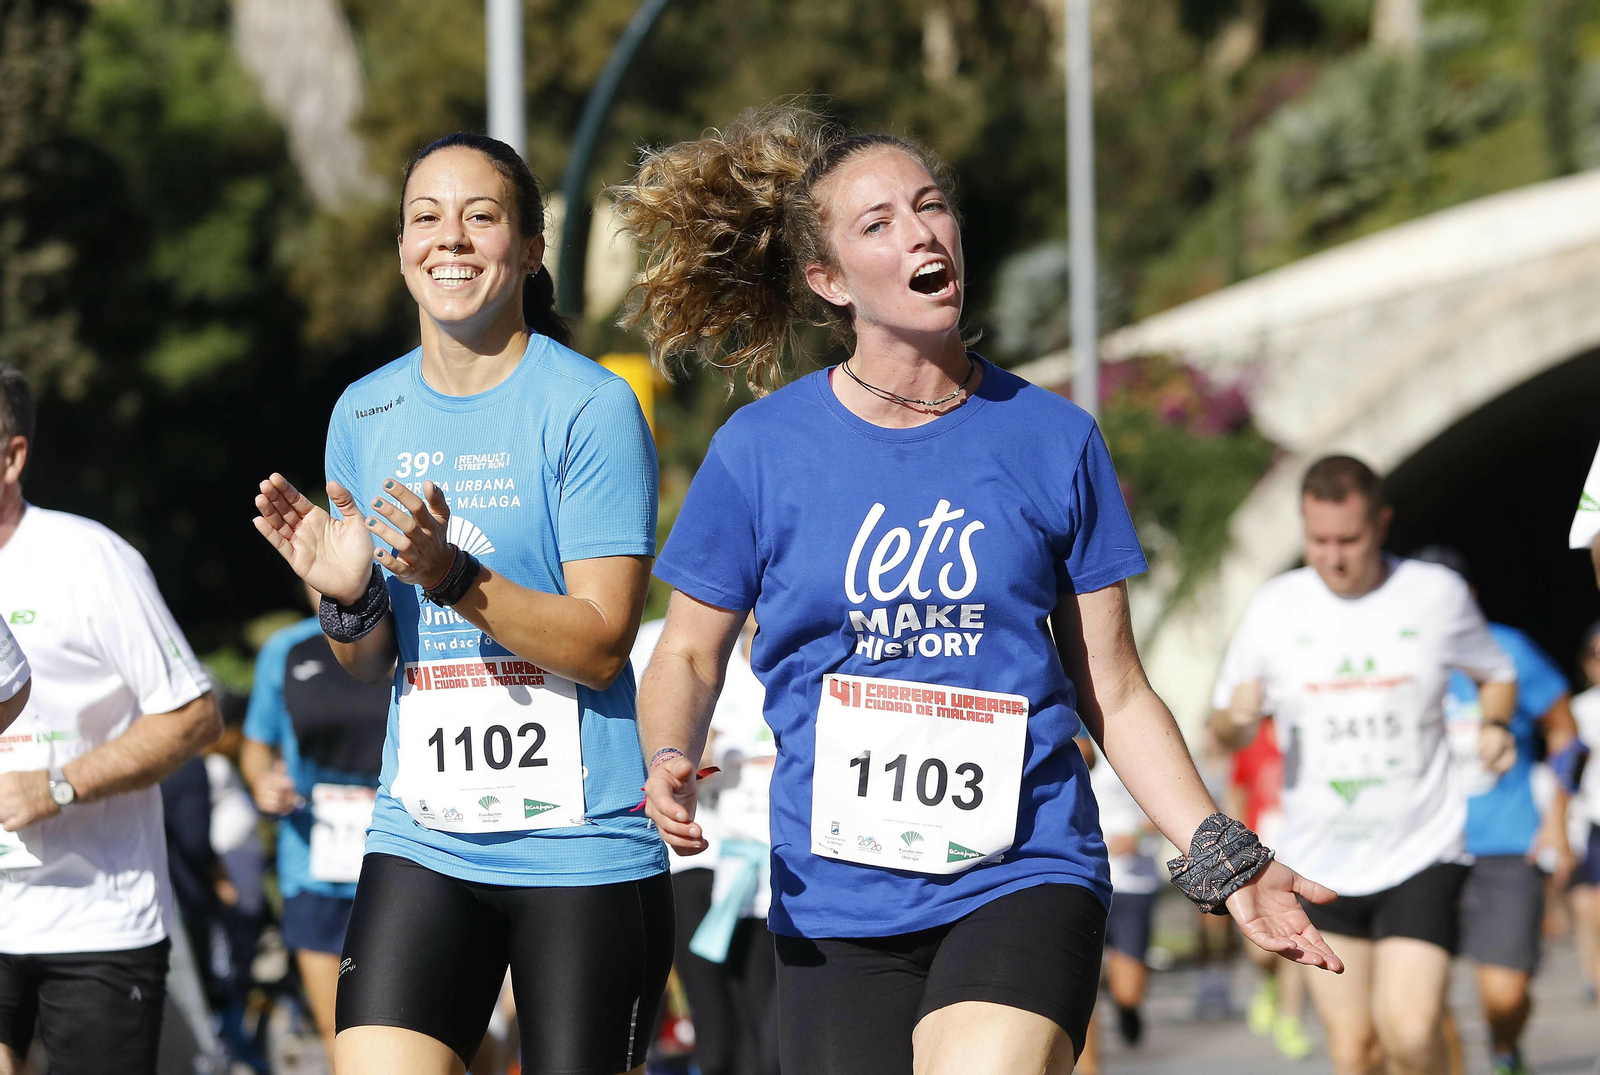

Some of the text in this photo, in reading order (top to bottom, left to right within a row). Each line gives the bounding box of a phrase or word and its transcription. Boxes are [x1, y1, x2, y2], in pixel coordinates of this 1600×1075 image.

[355, 402, 393, 419] luanvi
[458, 461, 505, 471] STREET RUN
[459, 452, 506, 464] RENAULT
[455, 478, 515, 493] URBANA
[457, 494, 521, 509] MÁLAGA
[844, 498, 985, 604] let's
[849, 603, 985, 638] MAKE
[855, 632, 983, 660] HISTORY
[407, 667, 432, 691] 41
[432, 662, 498, 678] CARRERA
[434, 675, 545, 690] CIUDAD DE MÁLAGA
[829, 678, 1024, 716] 41 CARRERA URBANA
[865, 698, 994, 724] CIUDAD DE MÁLAGA
[428, 722, 548, 772] 1102
[850, 750, 984, 811] 1103
[858, 835, 882, 852] 2020
